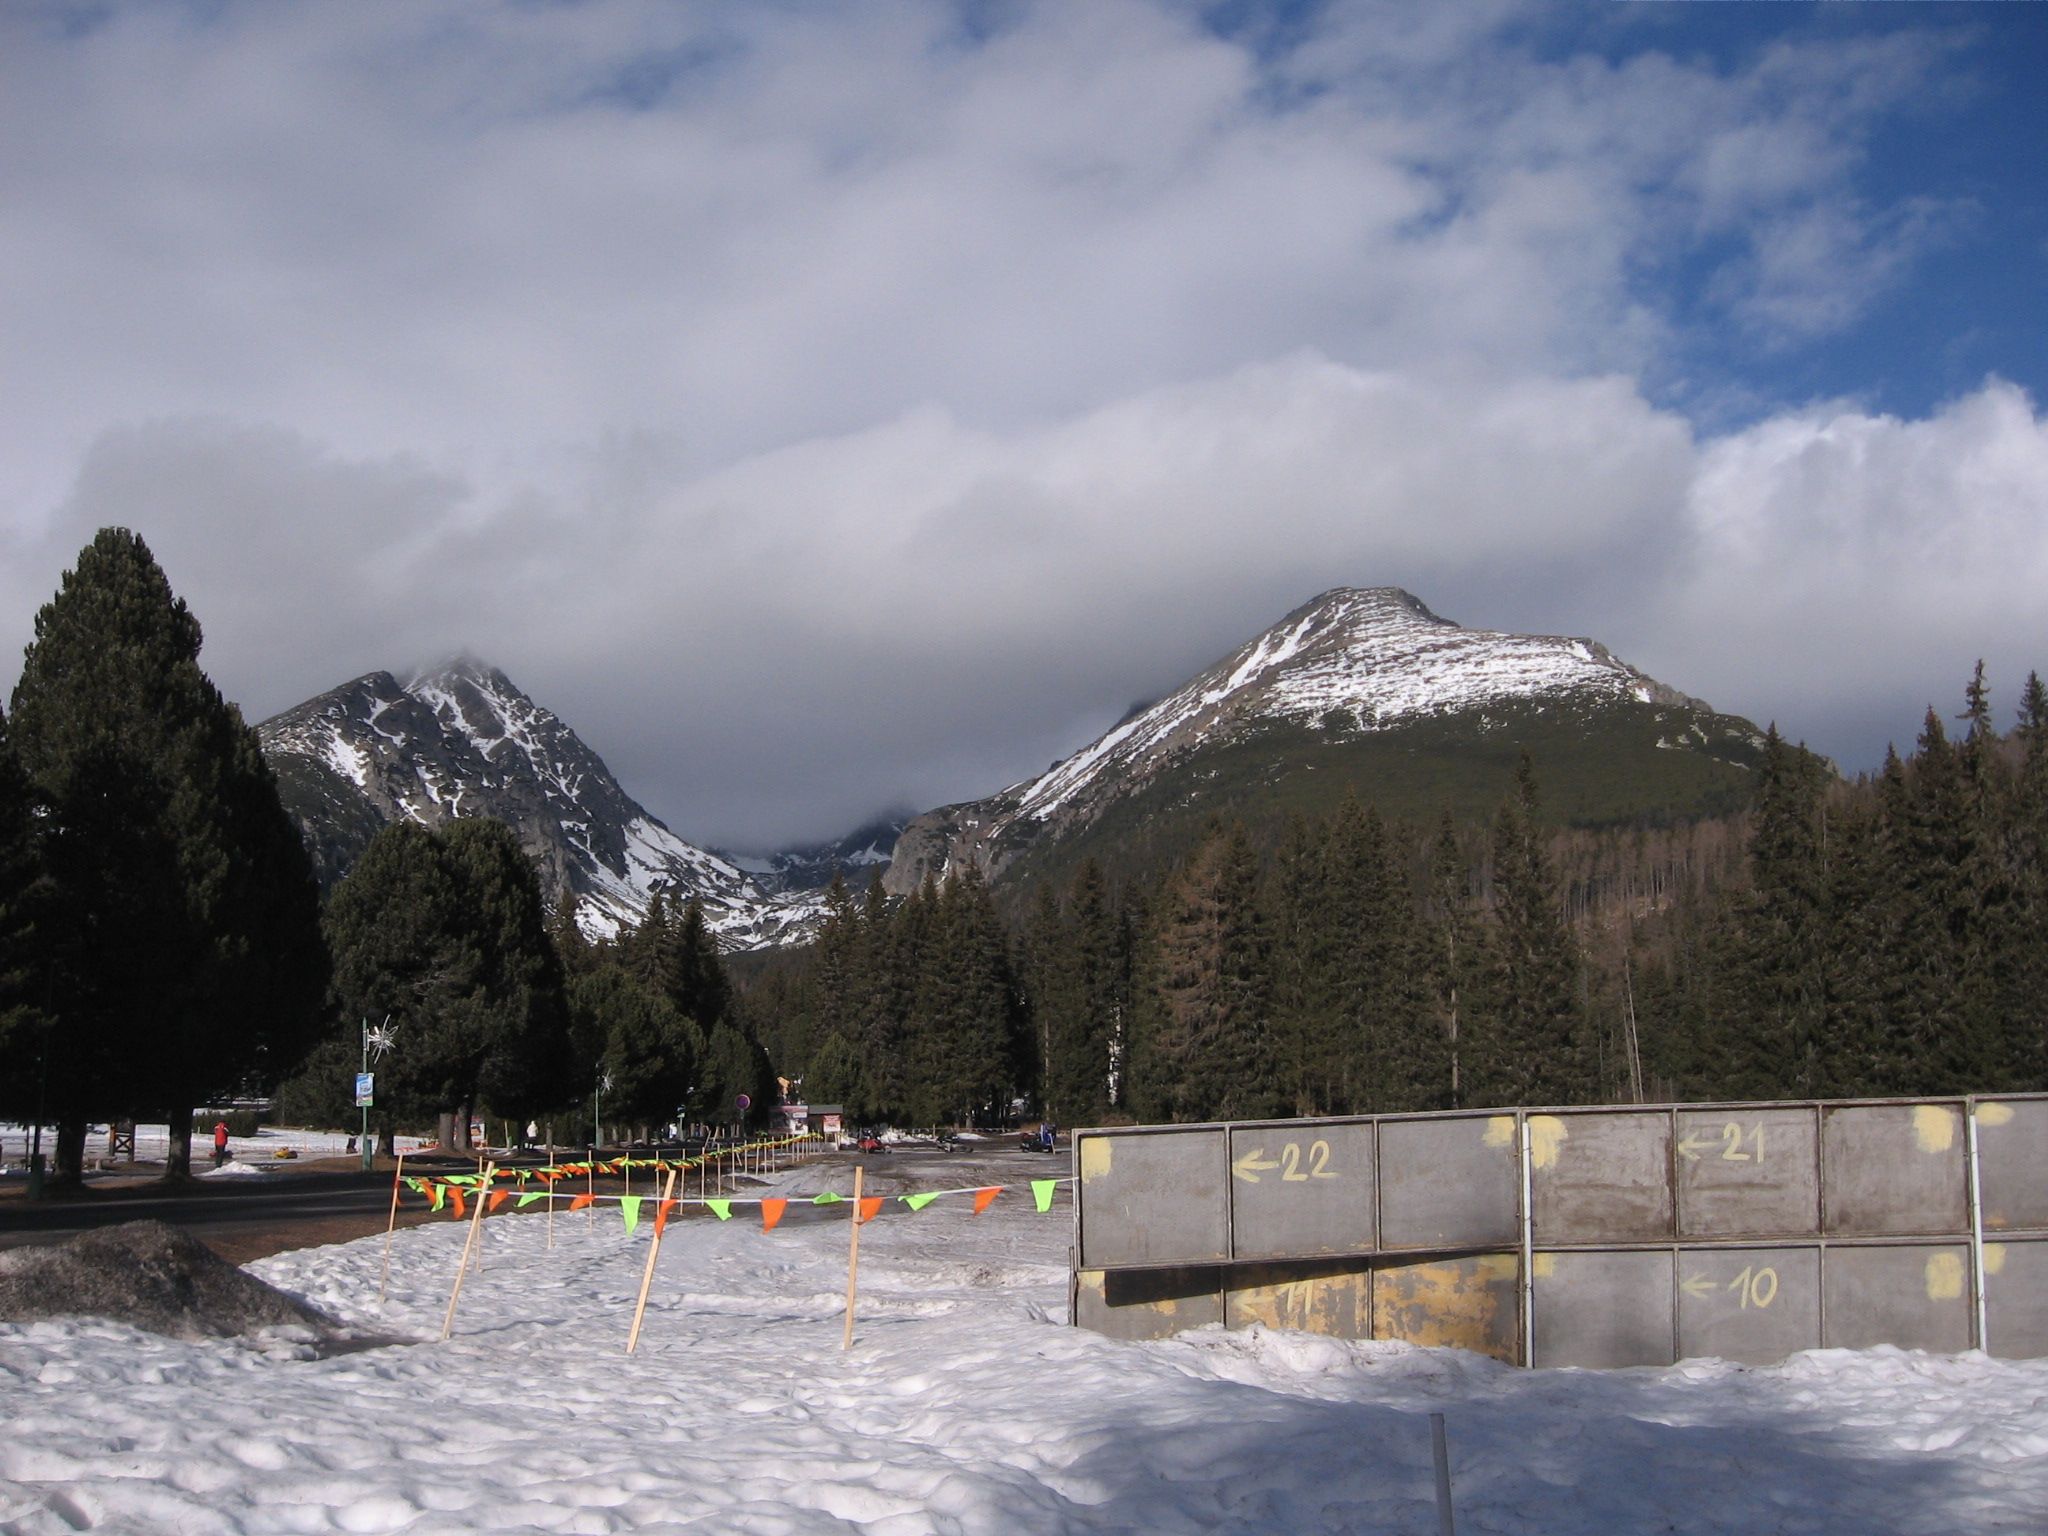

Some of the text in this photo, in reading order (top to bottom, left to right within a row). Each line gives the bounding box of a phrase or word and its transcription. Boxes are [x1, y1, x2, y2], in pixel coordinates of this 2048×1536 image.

[1281, 1140, 1339, 1181] 22
[1722, 1121, 1764, 1163] 21
[1275, 1279, 1314, 1315] 11
[1728, 1266, 1778, 1309] 10
